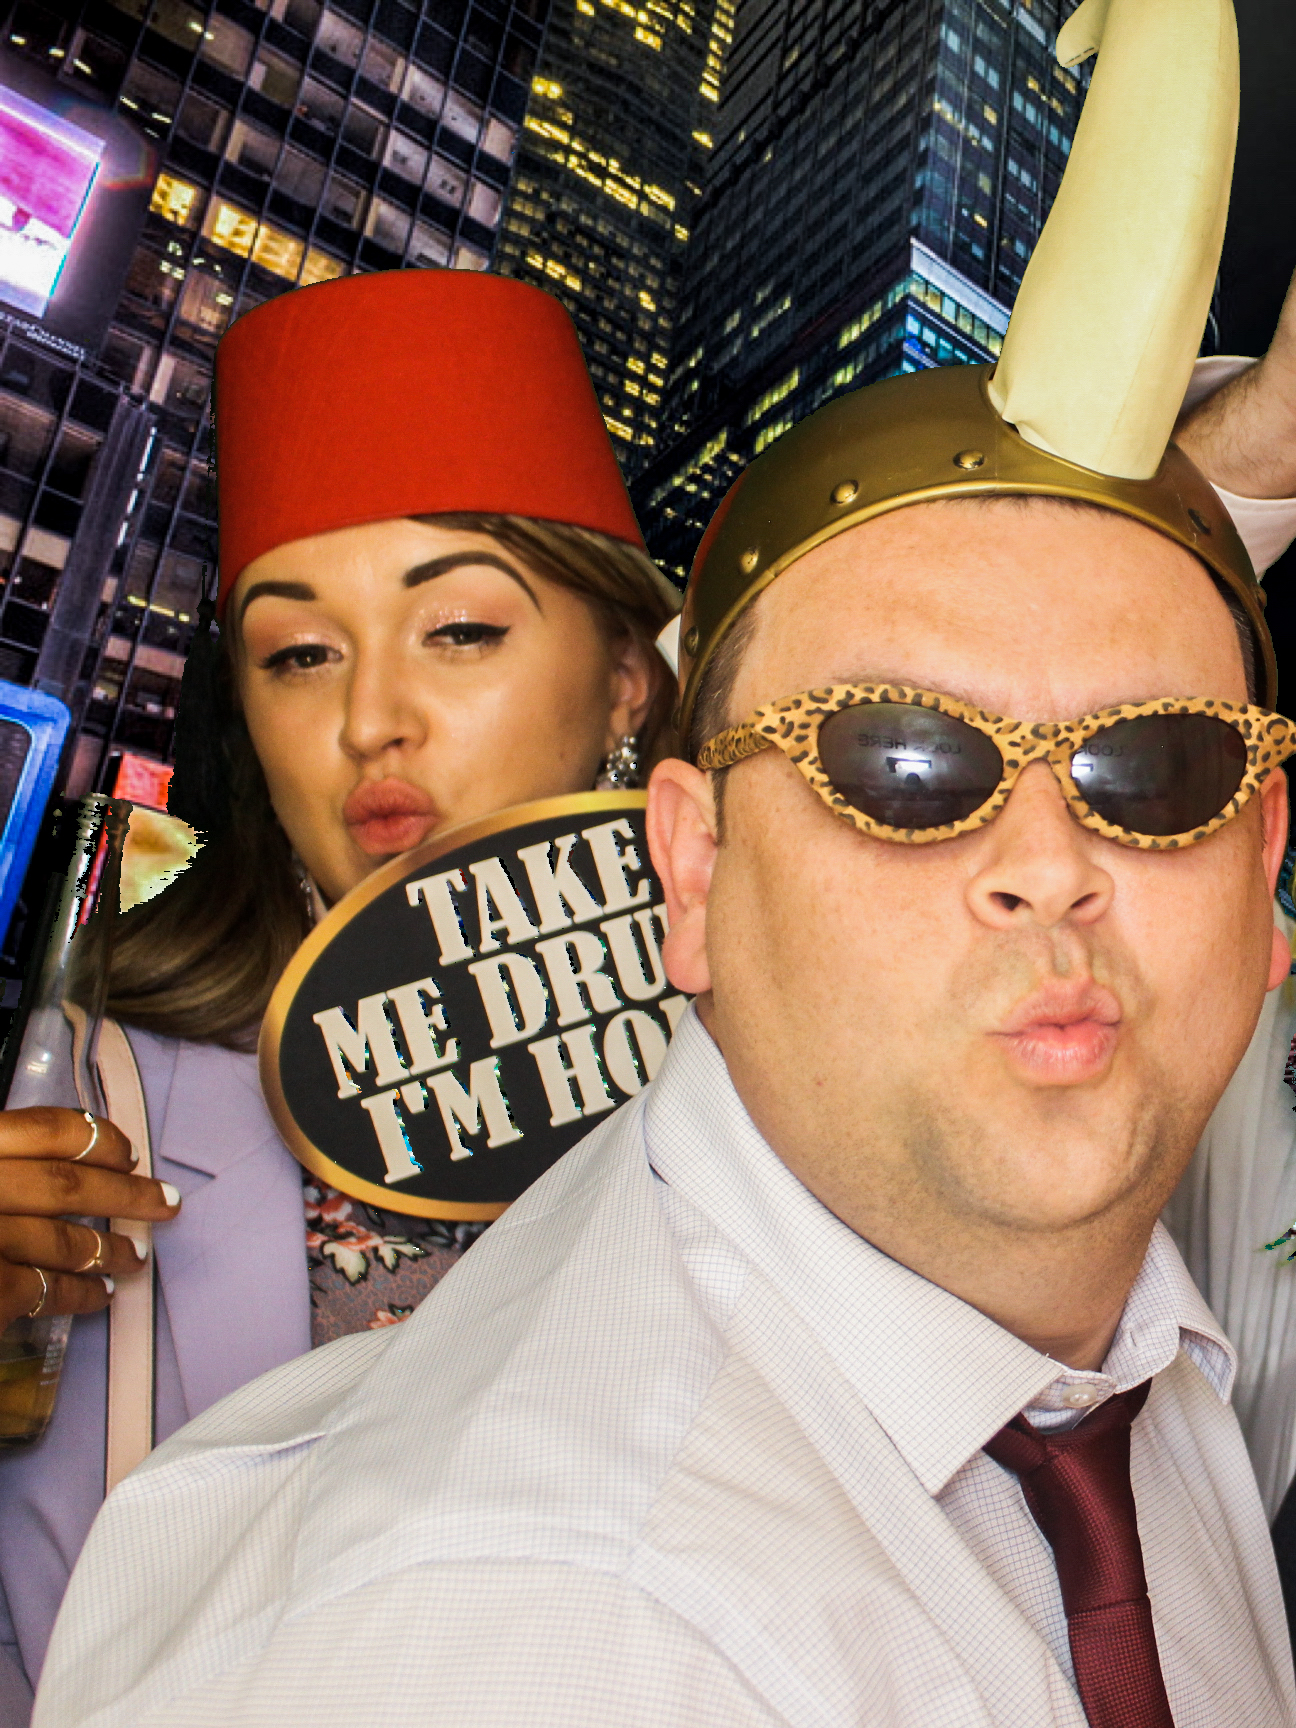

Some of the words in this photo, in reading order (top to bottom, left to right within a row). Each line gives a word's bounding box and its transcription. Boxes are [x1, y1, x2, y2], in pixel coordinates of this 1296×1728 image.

[405, 817, 652, 967] TAKE
[312, 977, 461, 1100] ME
[468, 903, 670, 1050] DRU
[361, 1055, 524, 1185] I'M
[528, 994, 689, 1128] HO
